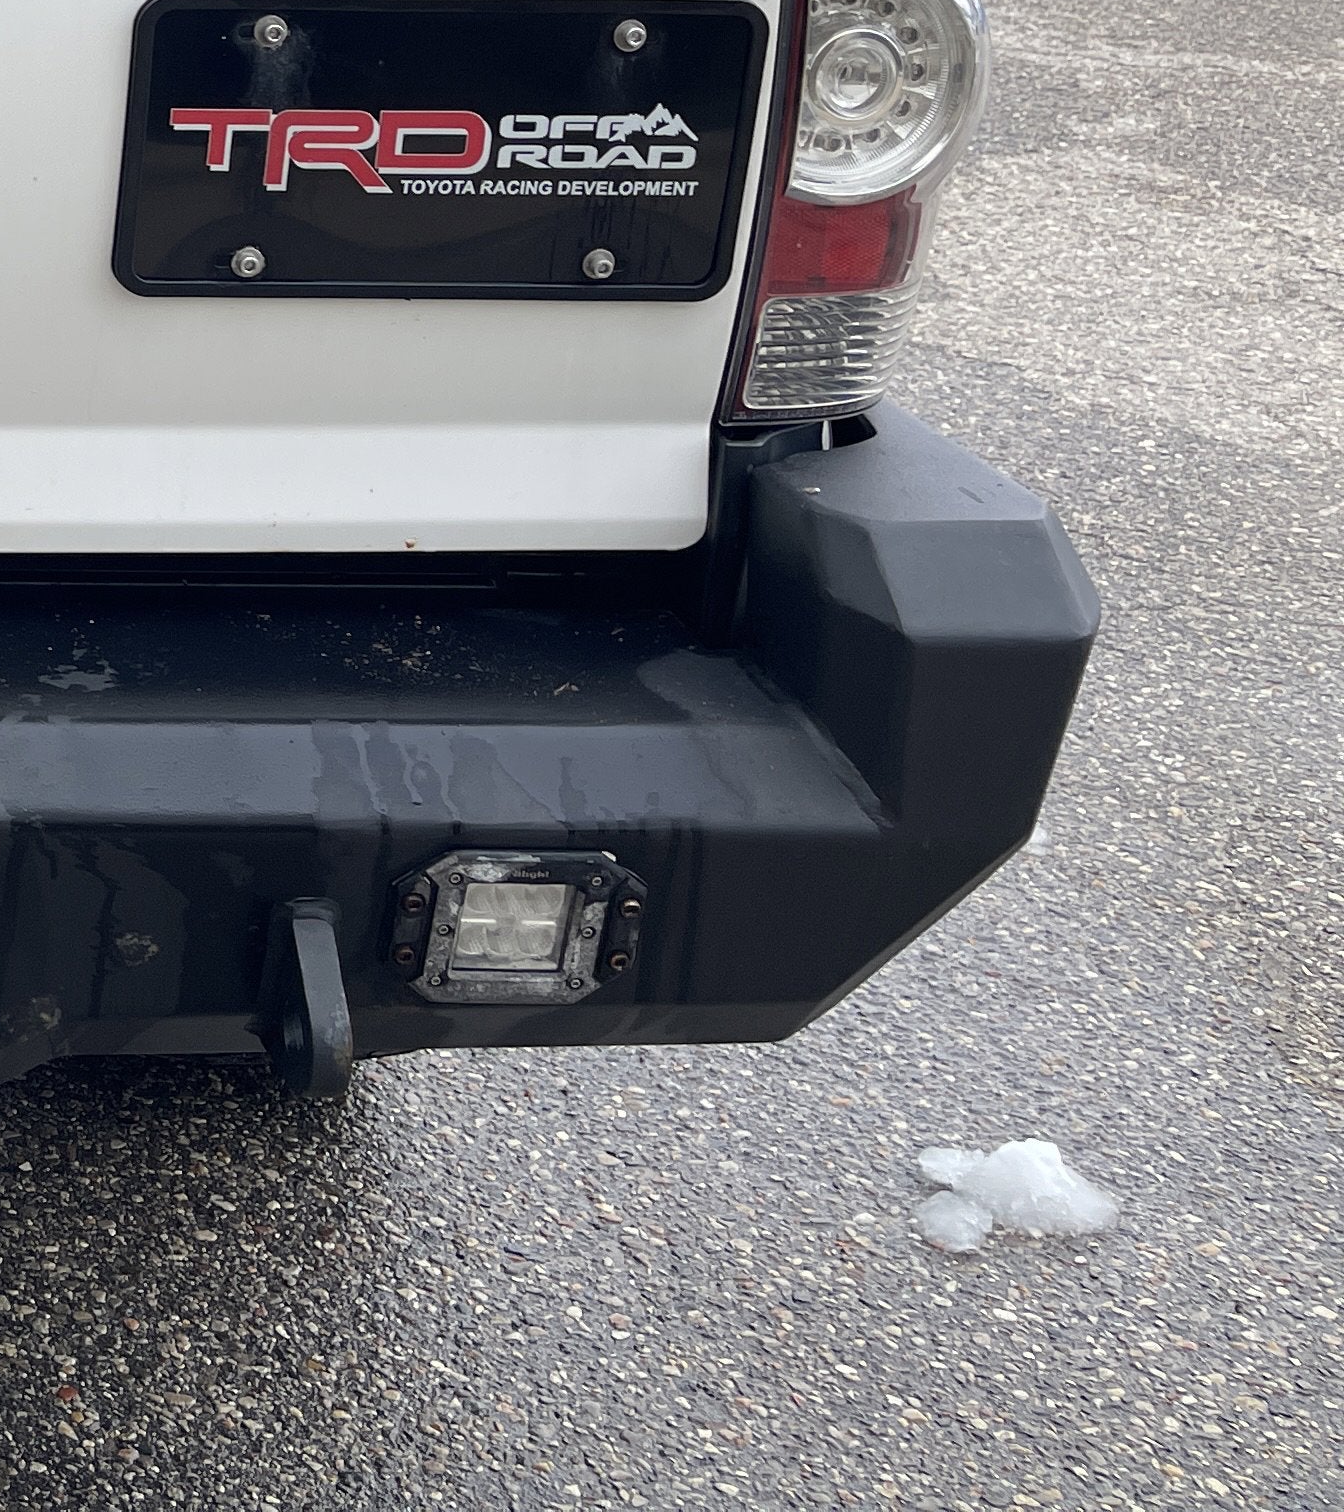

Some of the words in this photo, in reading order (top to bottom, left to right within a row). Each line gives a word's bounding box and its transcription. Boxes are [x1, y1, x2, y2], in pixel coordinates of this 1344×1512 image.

[169, 107, 493, 194] TRD
[496, 144, 697, 170] ROAD
[400, 179, 475, 195] TOYOTA
[479, 180, 553, 196] RACING
[557, 180, 699, 197] DEVELOPMENT
